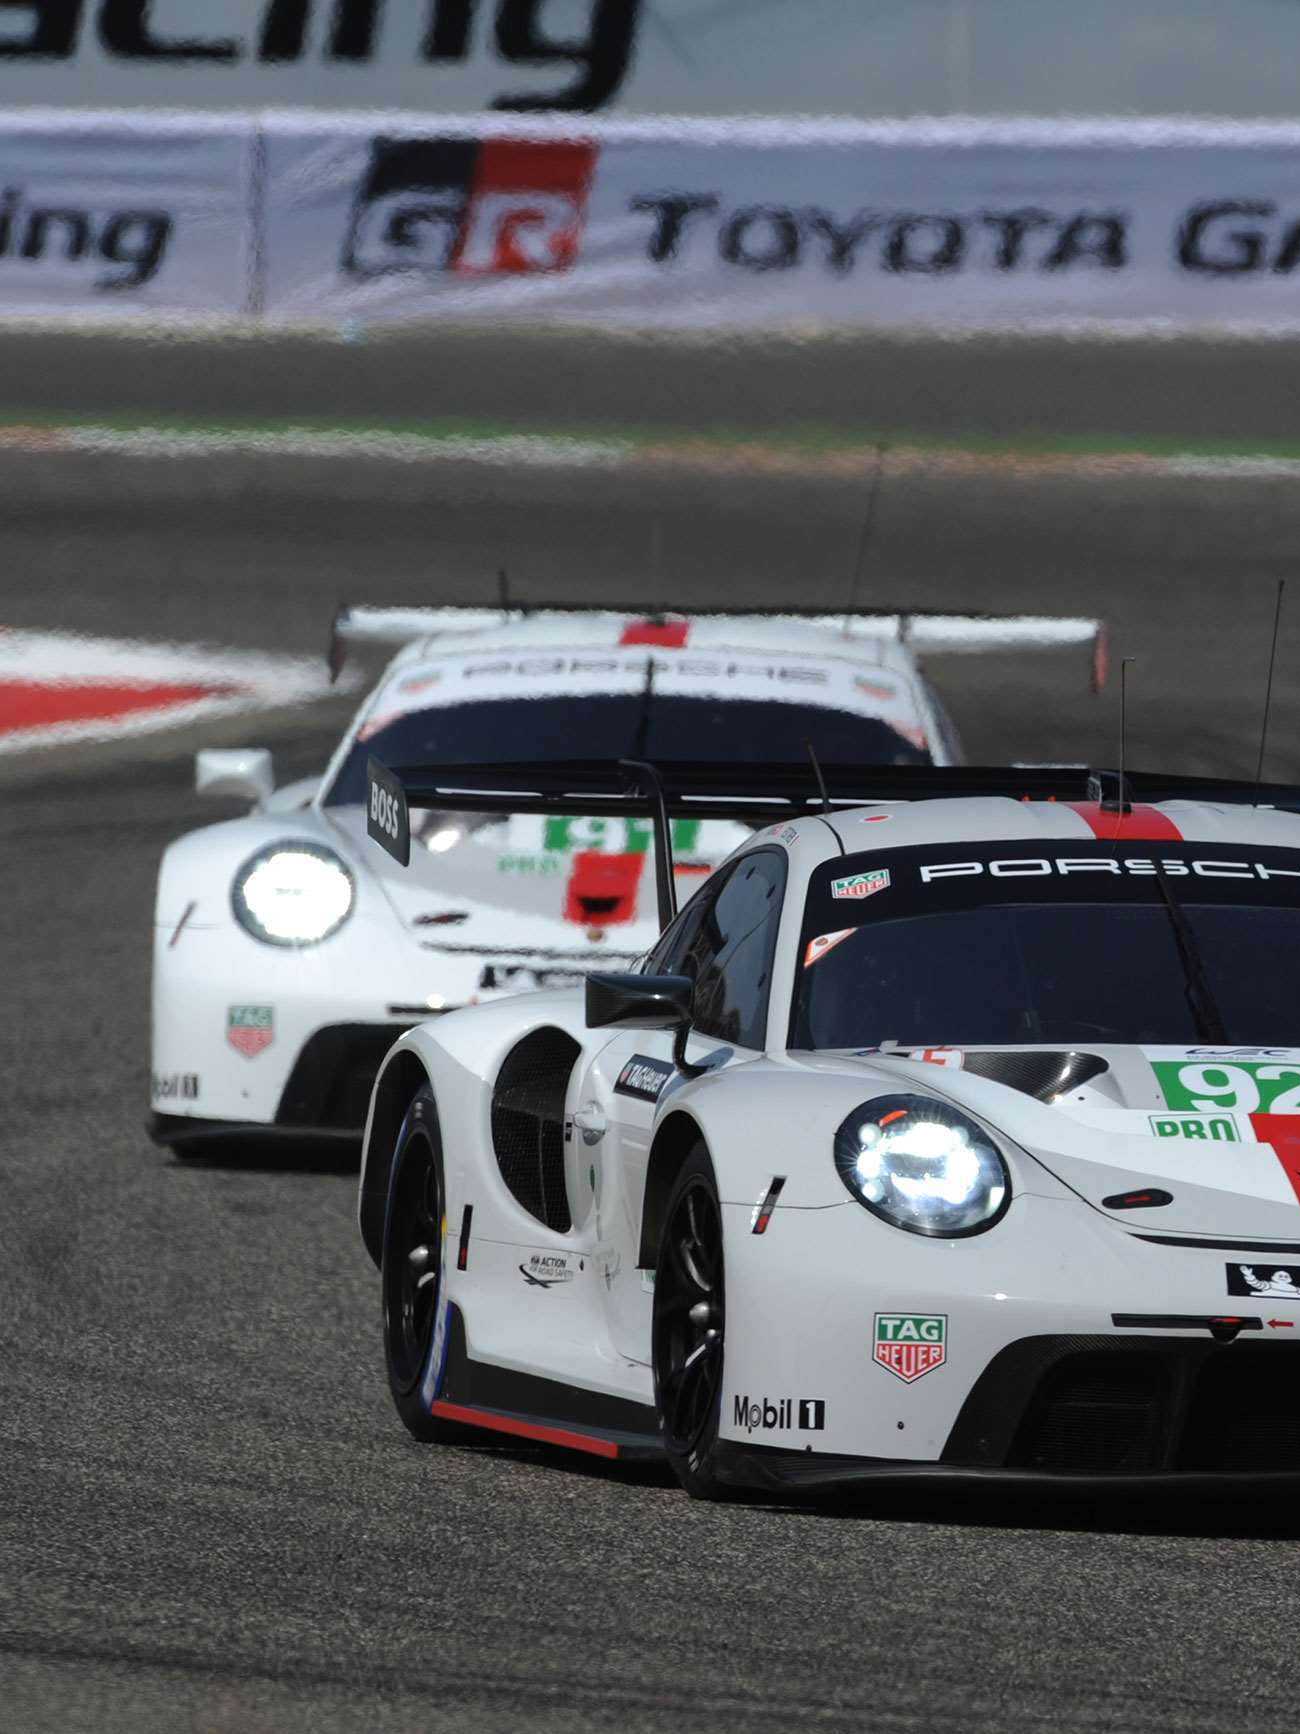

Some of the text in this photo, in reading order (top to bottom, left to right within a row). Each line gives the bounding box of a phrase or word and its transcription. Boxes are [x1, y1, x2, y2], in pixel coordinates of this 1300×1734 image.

[630, 191, 1130, 275] TOYOTA
[370, 781, 399, 840] BOSS
[835, 870, 886, 890] TAG
[1154, 1118, 1237, 1142] PRO
[540, 1257, 567, 1269] ACTION
[881, 1318, 940, 1341] TAG
[878, 1344, 942, 1378] HEUER
[734, 1395, 792, 1430] Mobil
